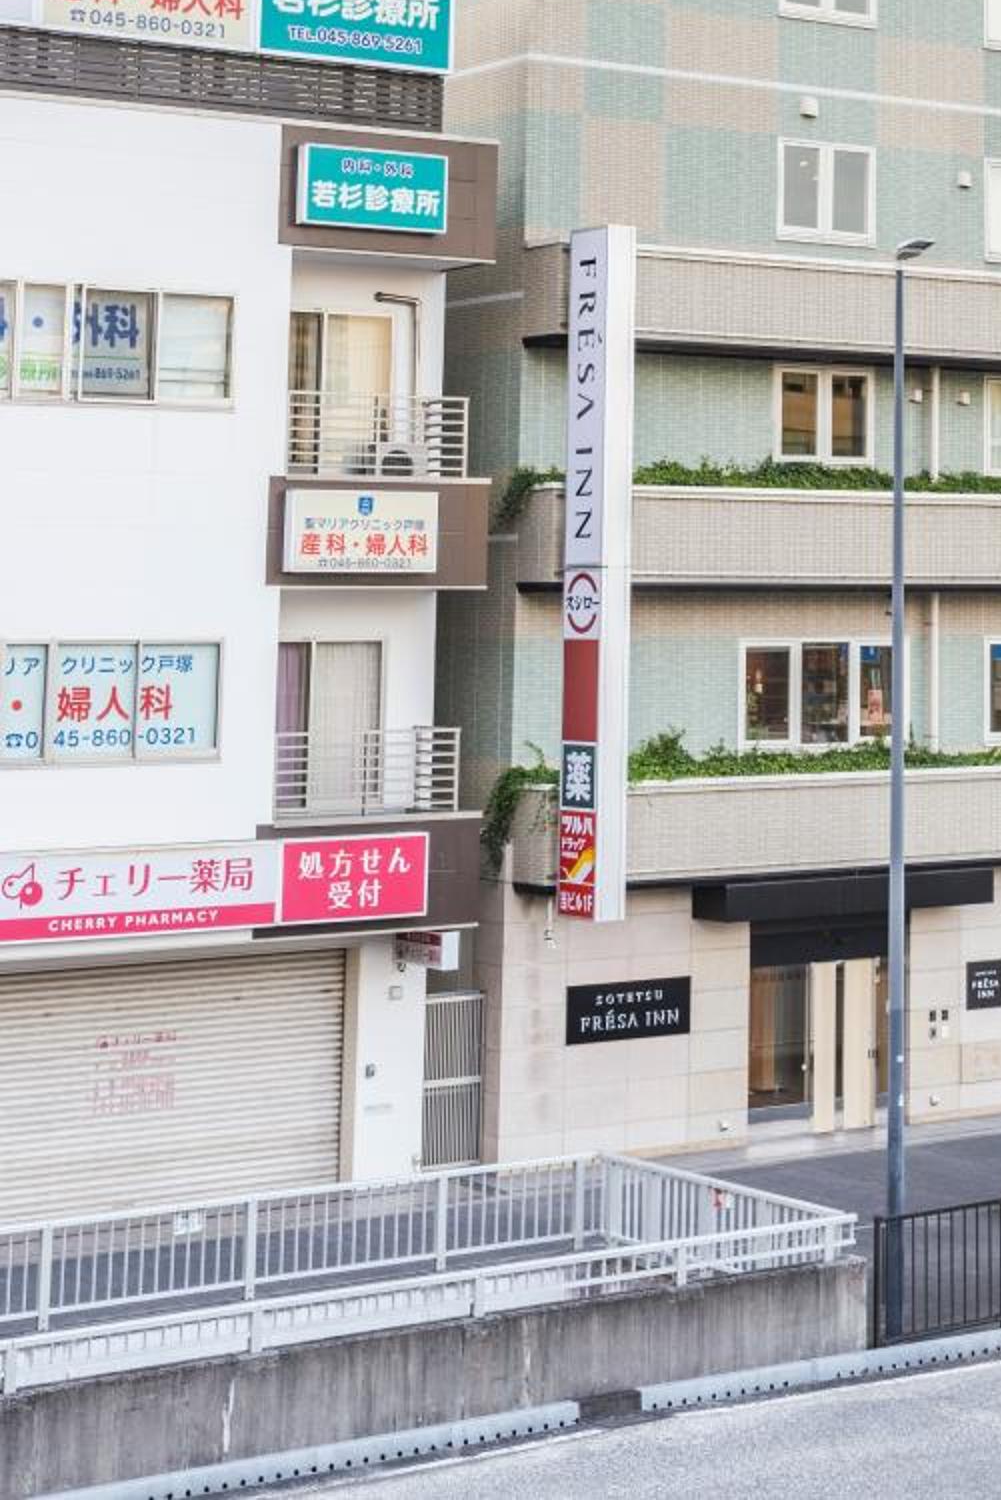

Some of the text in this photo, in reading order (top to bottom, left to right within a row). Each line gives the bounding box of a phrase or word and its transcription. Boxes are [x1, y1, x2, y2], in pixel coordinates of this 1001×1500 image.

[89, 9, 225, 39] 045-860-0321
[311, 179, 442, 218] 若杉診療所
[574, 256, 603, 539] FRÉSA INN
[301, 532, 429, 558] 産科・婦人科
[566, 595, 601, 612] スシロー
[565, 750, 592, 802] 薬
[55, 856, 254, 901] チェリー薬局
[298, 847, 411, 880] 処方せん
[327, 879, 382, 911] 受付
[48, 909, 219, 933] CHERRY PHARMACY
[645, 1007, 680, 1027] INN
